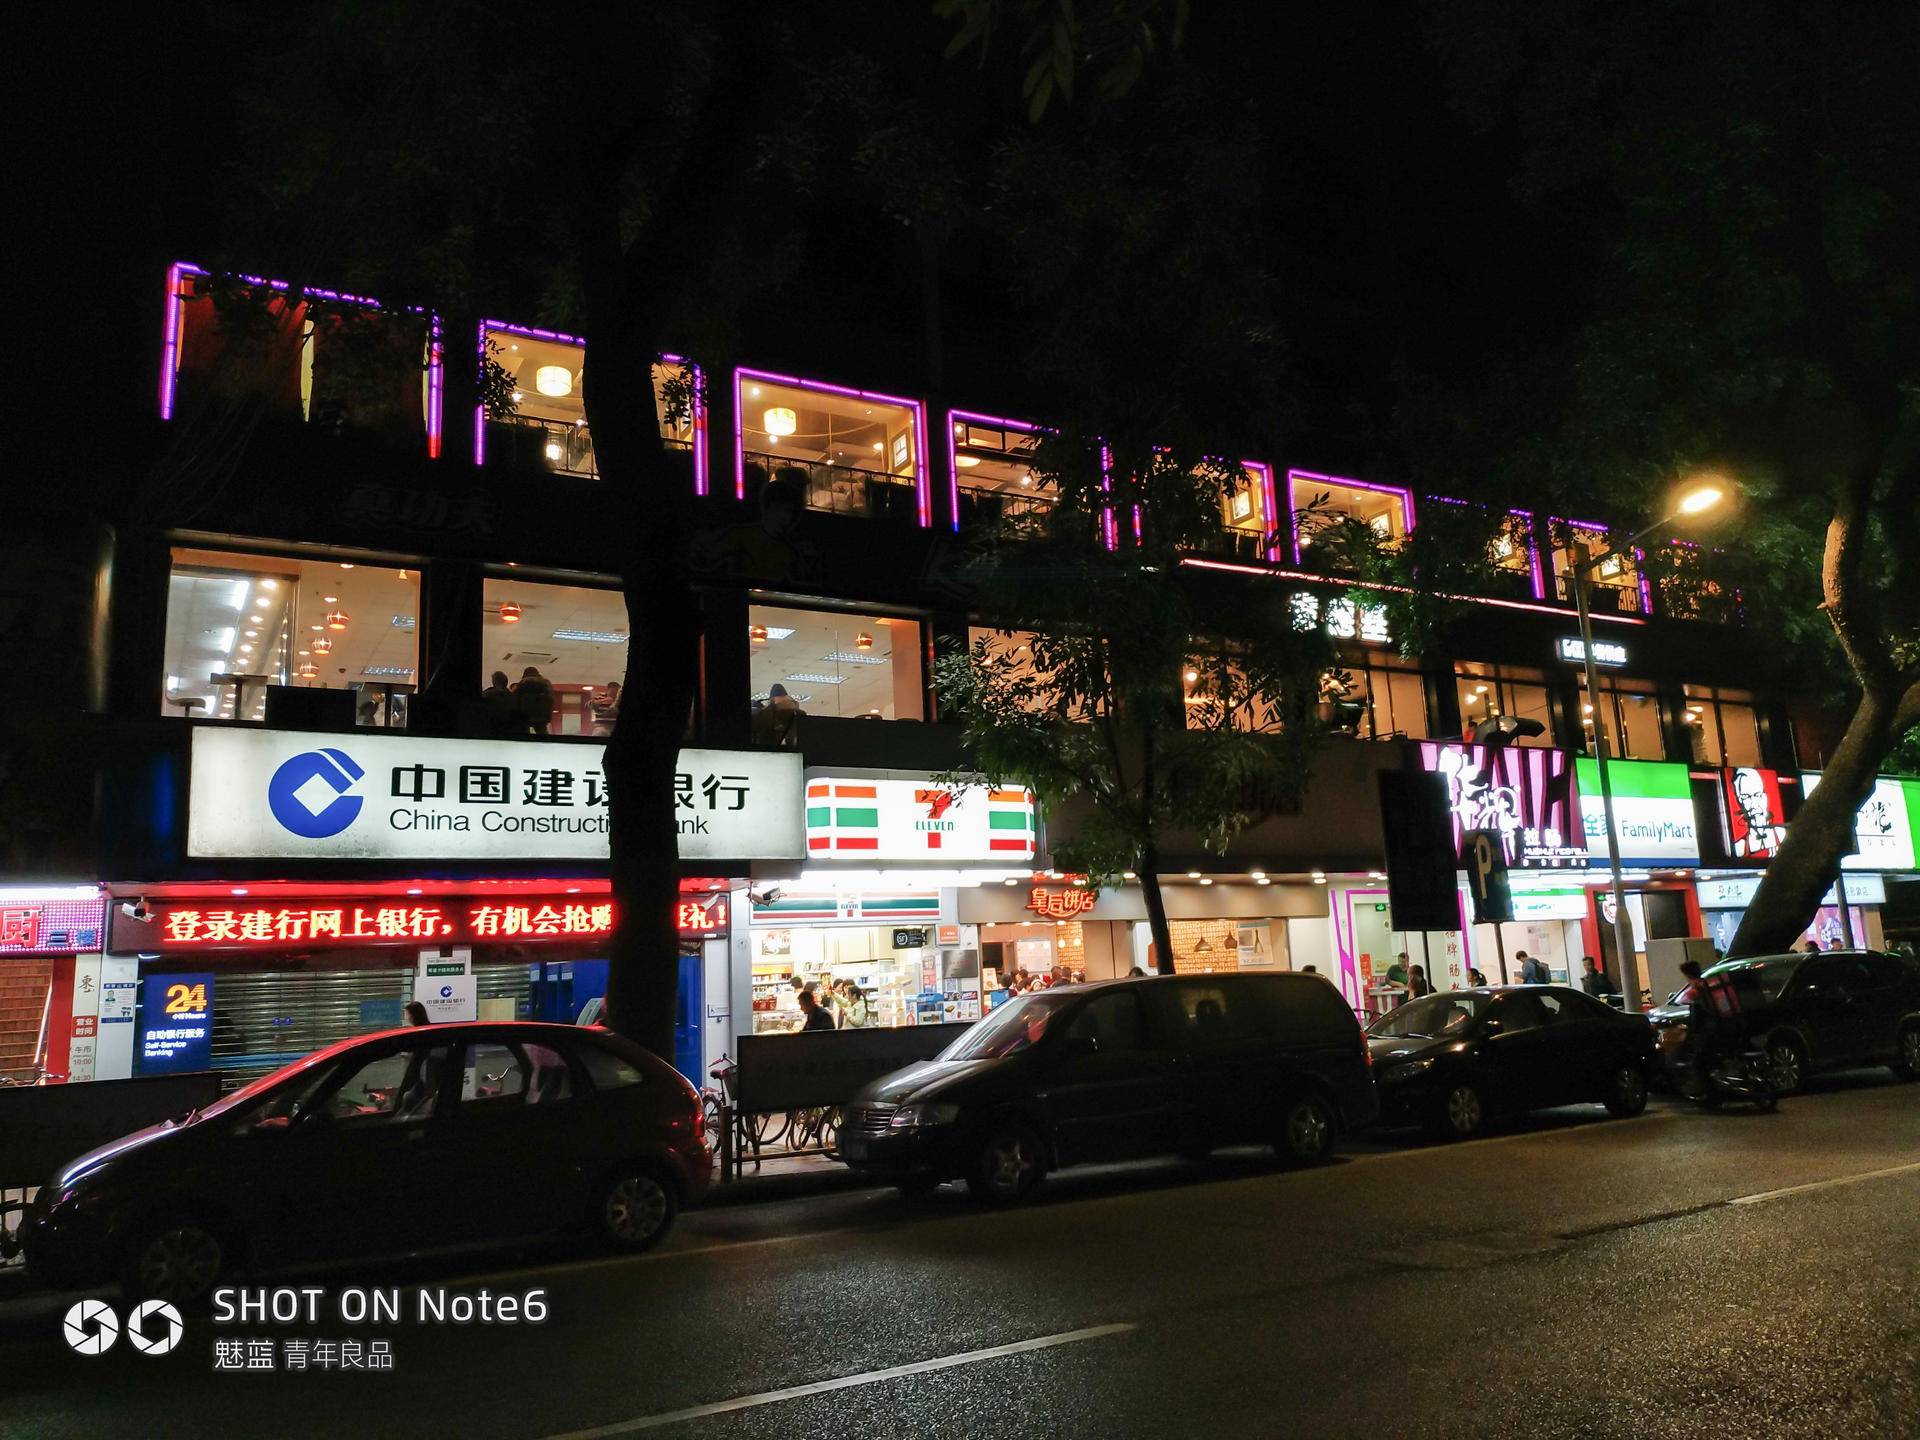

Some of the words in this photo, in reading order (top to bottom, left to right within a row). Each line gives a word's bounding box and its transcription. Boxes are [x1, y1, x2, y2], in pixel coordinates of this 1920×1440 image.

[389, 808, 471, 832] China
[481, 810, 610, 834] Constructi
[675, 815, 709, 834] nk
[1621, 820, 1693, 843] FamilyMart
[1474, 833, 1493, 900] P
[1025, 887, 1096, 917] 皇后饼店
[165, 983, 207, 1013] 24
[146, 1028, 206, 1041] 自助银行服务
